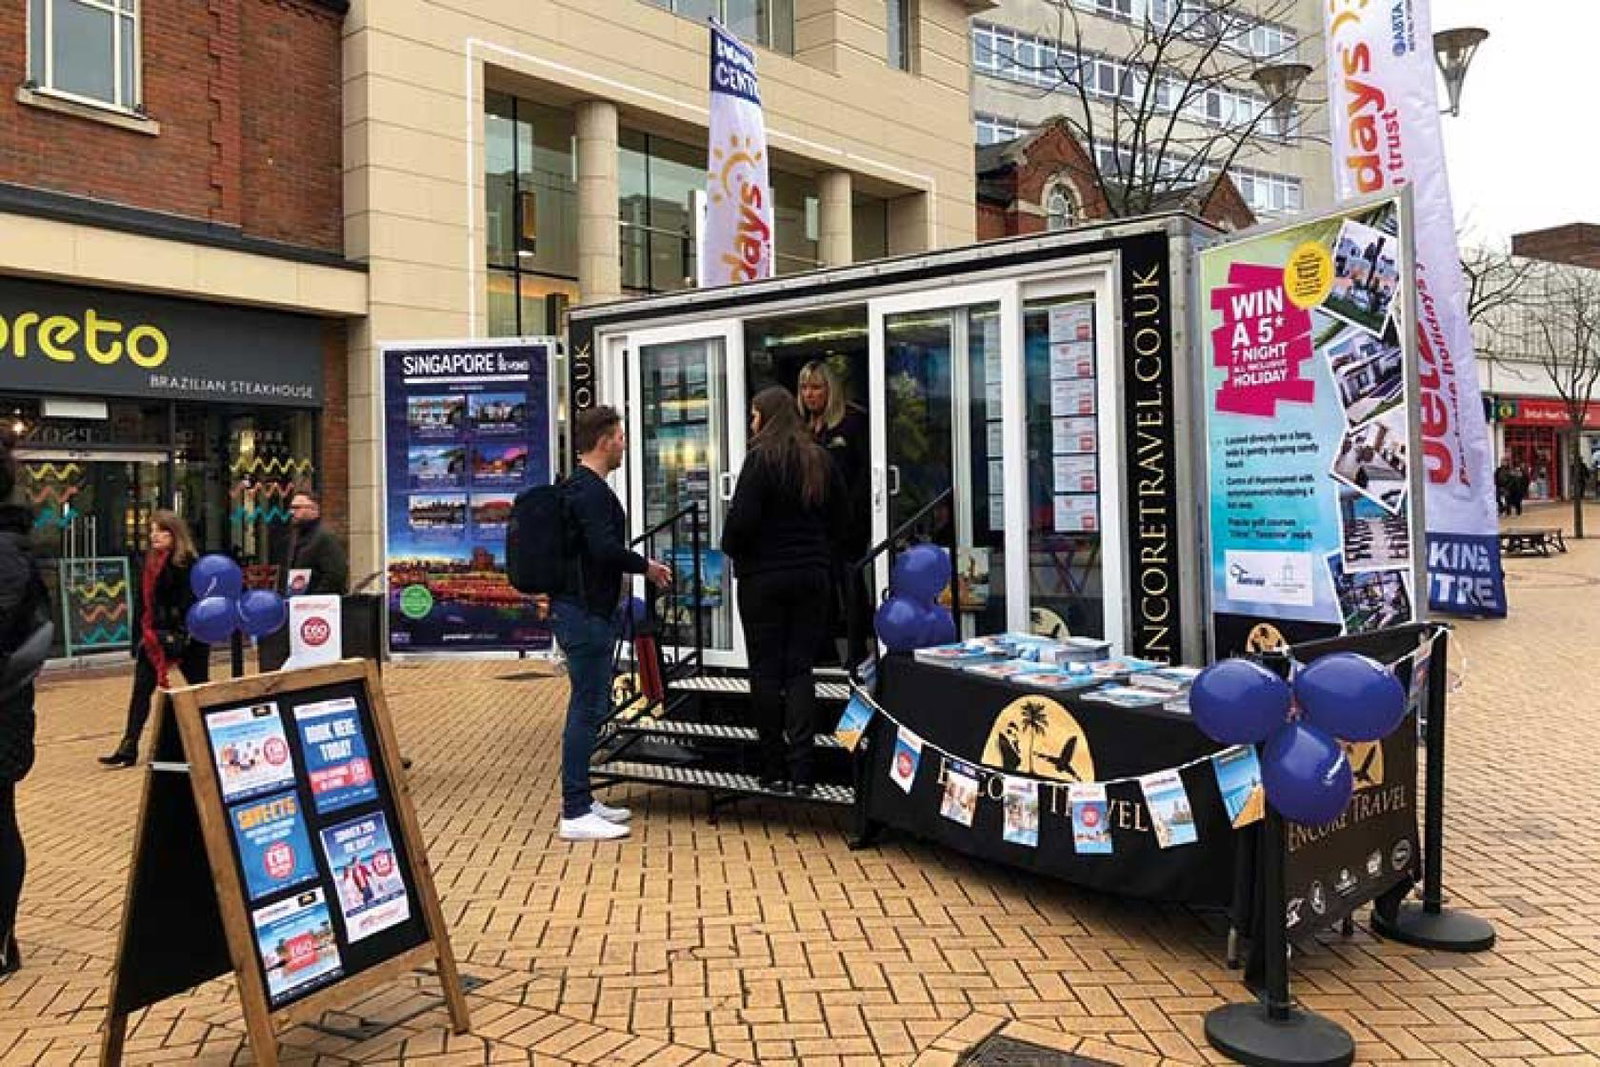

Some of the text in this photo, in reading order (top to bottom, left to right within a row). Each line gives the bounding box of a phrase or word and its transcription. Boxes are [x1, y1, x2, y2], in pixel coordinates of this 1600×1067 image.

[1342, 42, 1386, 193] days
[1382, 109, 1404, 171] trust
[1231, 286, 1284, 320] WIN
[0, 308, 170, 369] reto
[1231, 321, 1251, 349] A
[1243, 342, 1289, 362] NIGHT
[150, 373, 314, 400] BRAZILIAN STEAKHOUSE
[1233, 367, 1289, 387] HOLIDAY
[1351, 784, 1408, 823] TRAVEL
